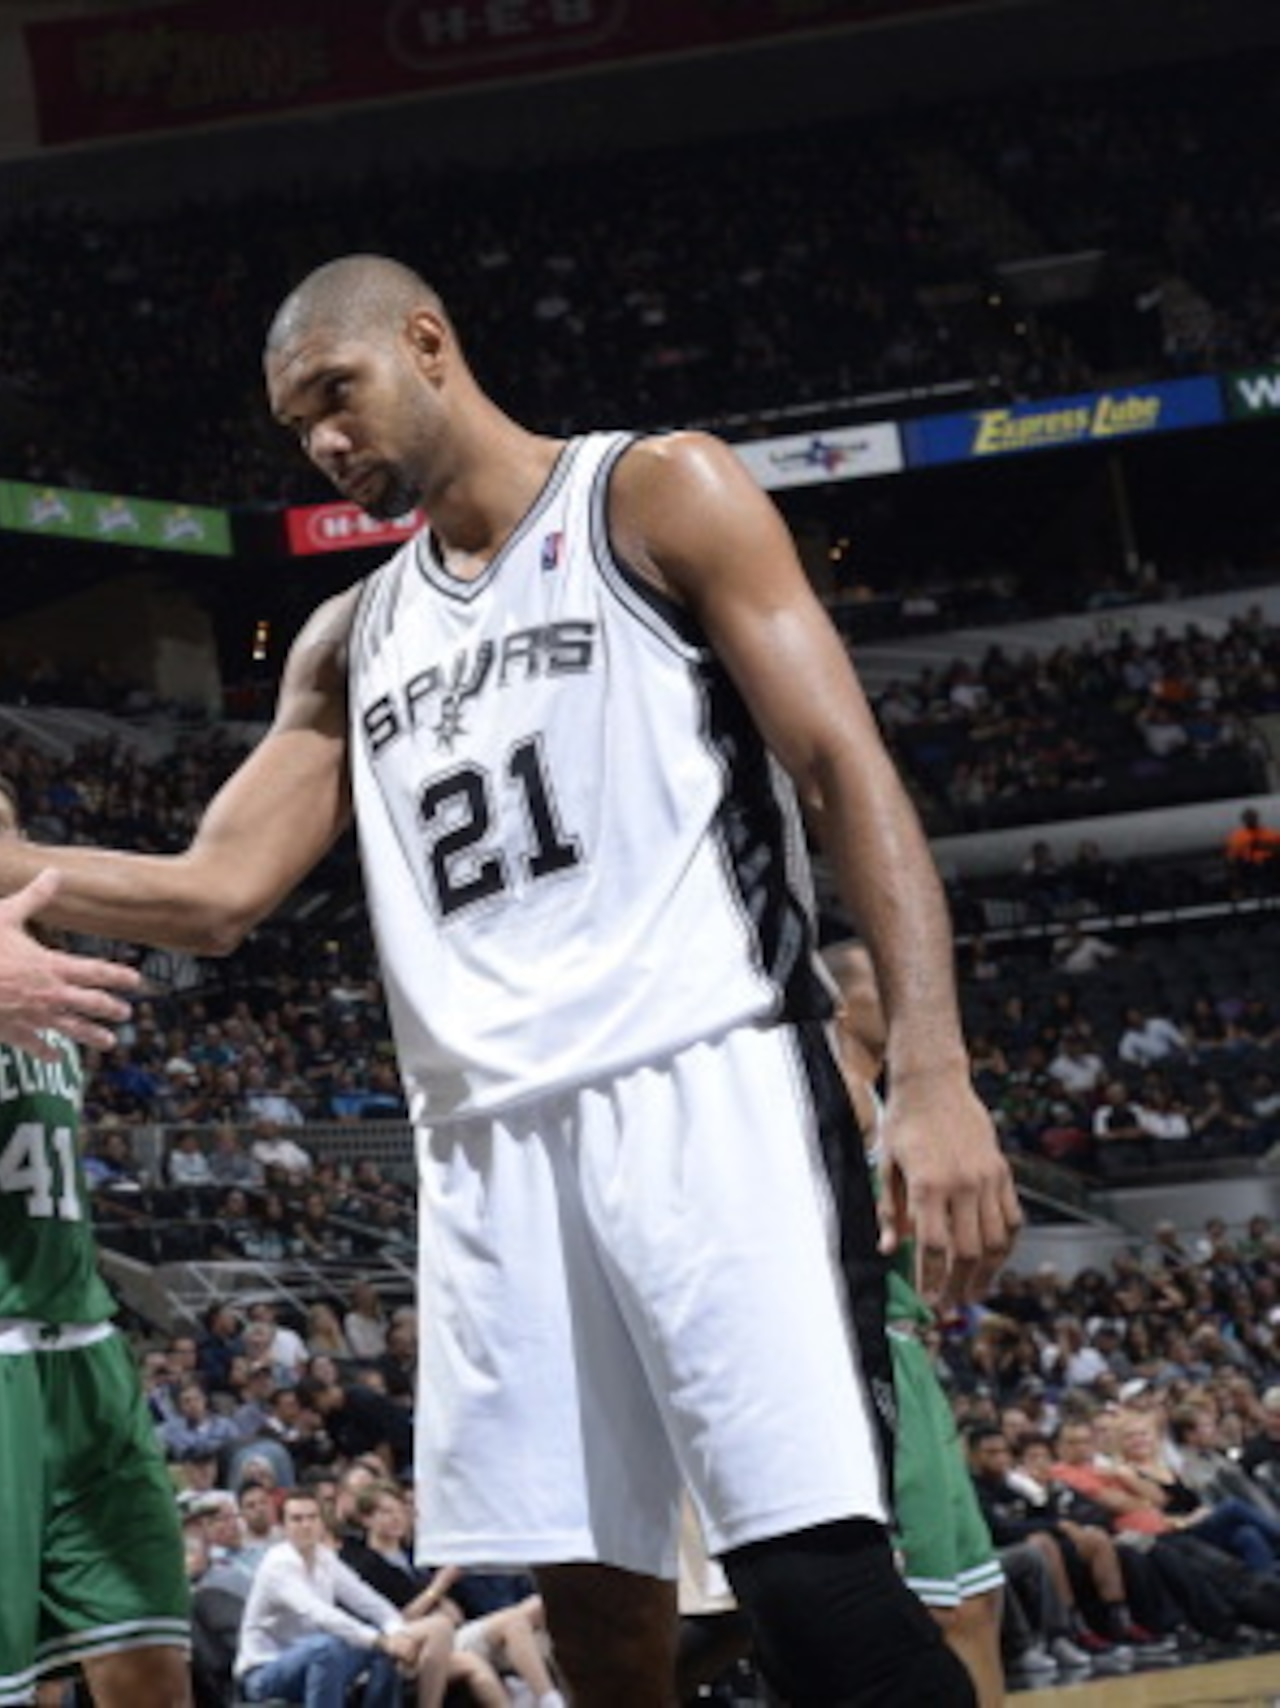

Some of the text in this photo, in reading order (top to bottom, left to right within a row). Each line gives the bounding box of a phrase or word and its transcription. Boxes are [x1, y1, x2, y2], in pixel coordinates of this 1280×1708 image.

[974, 396, 1161, 455] Express Lube
[363, 620, 596, 757] SPURS
[420, 731, 583, 923] 21
